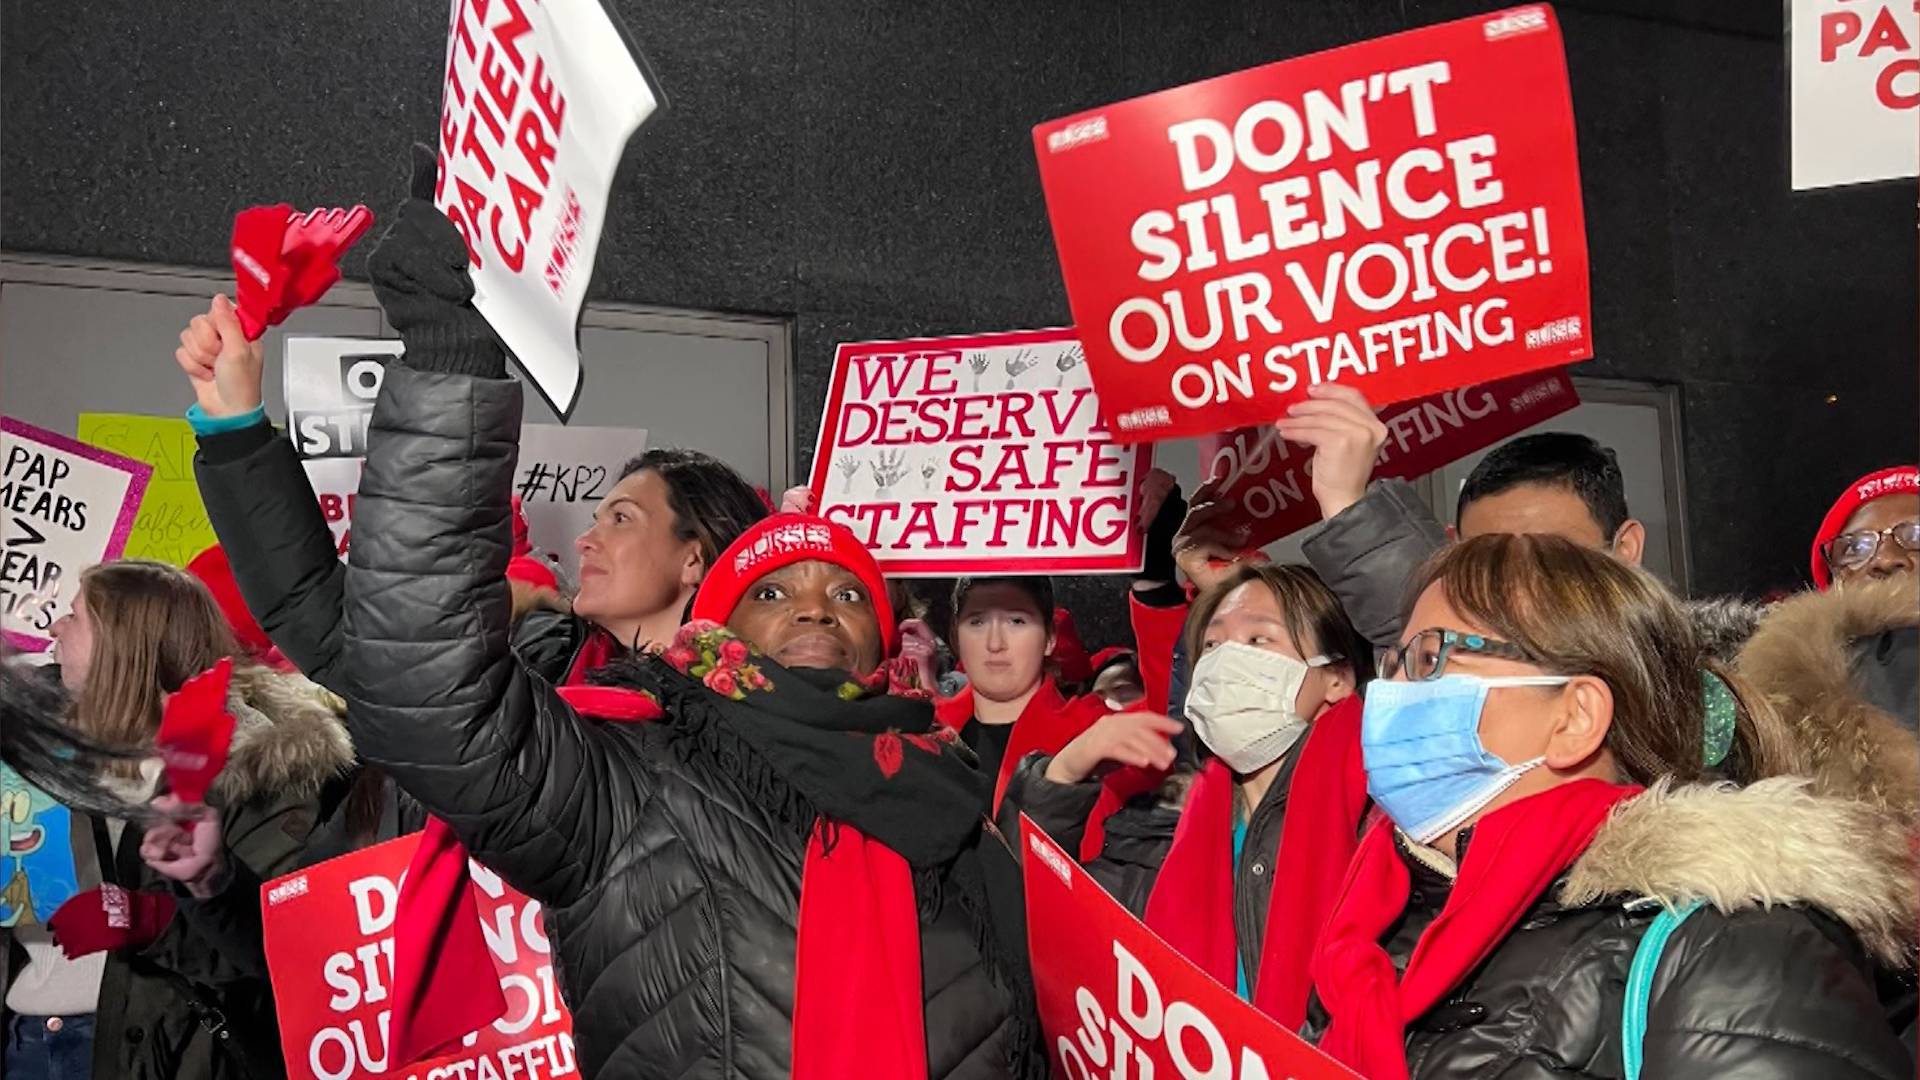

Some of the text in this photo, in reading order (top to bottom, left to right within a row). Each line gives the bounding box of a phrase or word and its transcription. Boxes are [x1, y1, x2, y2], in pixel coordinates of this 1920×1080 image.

[1820, 0, 1920, 62] PA
[447, 0, 542, 271] PATIEN
[1168, 61, 1450, 192] DON'T
[490, 52, 566, 273] CARE
[1130, 134, 1503, 282] SILENCE
[1109, 207, 1553, 363] OUR VOICE!
[852, 351, 962, 400] WE
[1171, 298, 1515, 408] ON STAFFING
[4, 445, 70, 489] PAP
[517, 463, 606, 502] #KP2
[944, 440, 1128, 492] SAFE
[1243, 468, 1305, 519] ON
[824, 496, 1129, 550] STAFFING
[0, 549, 62, 598] EAR
[1113, 939, 1292, 1080] DO
[309, 1010, 391, 1080] OU
